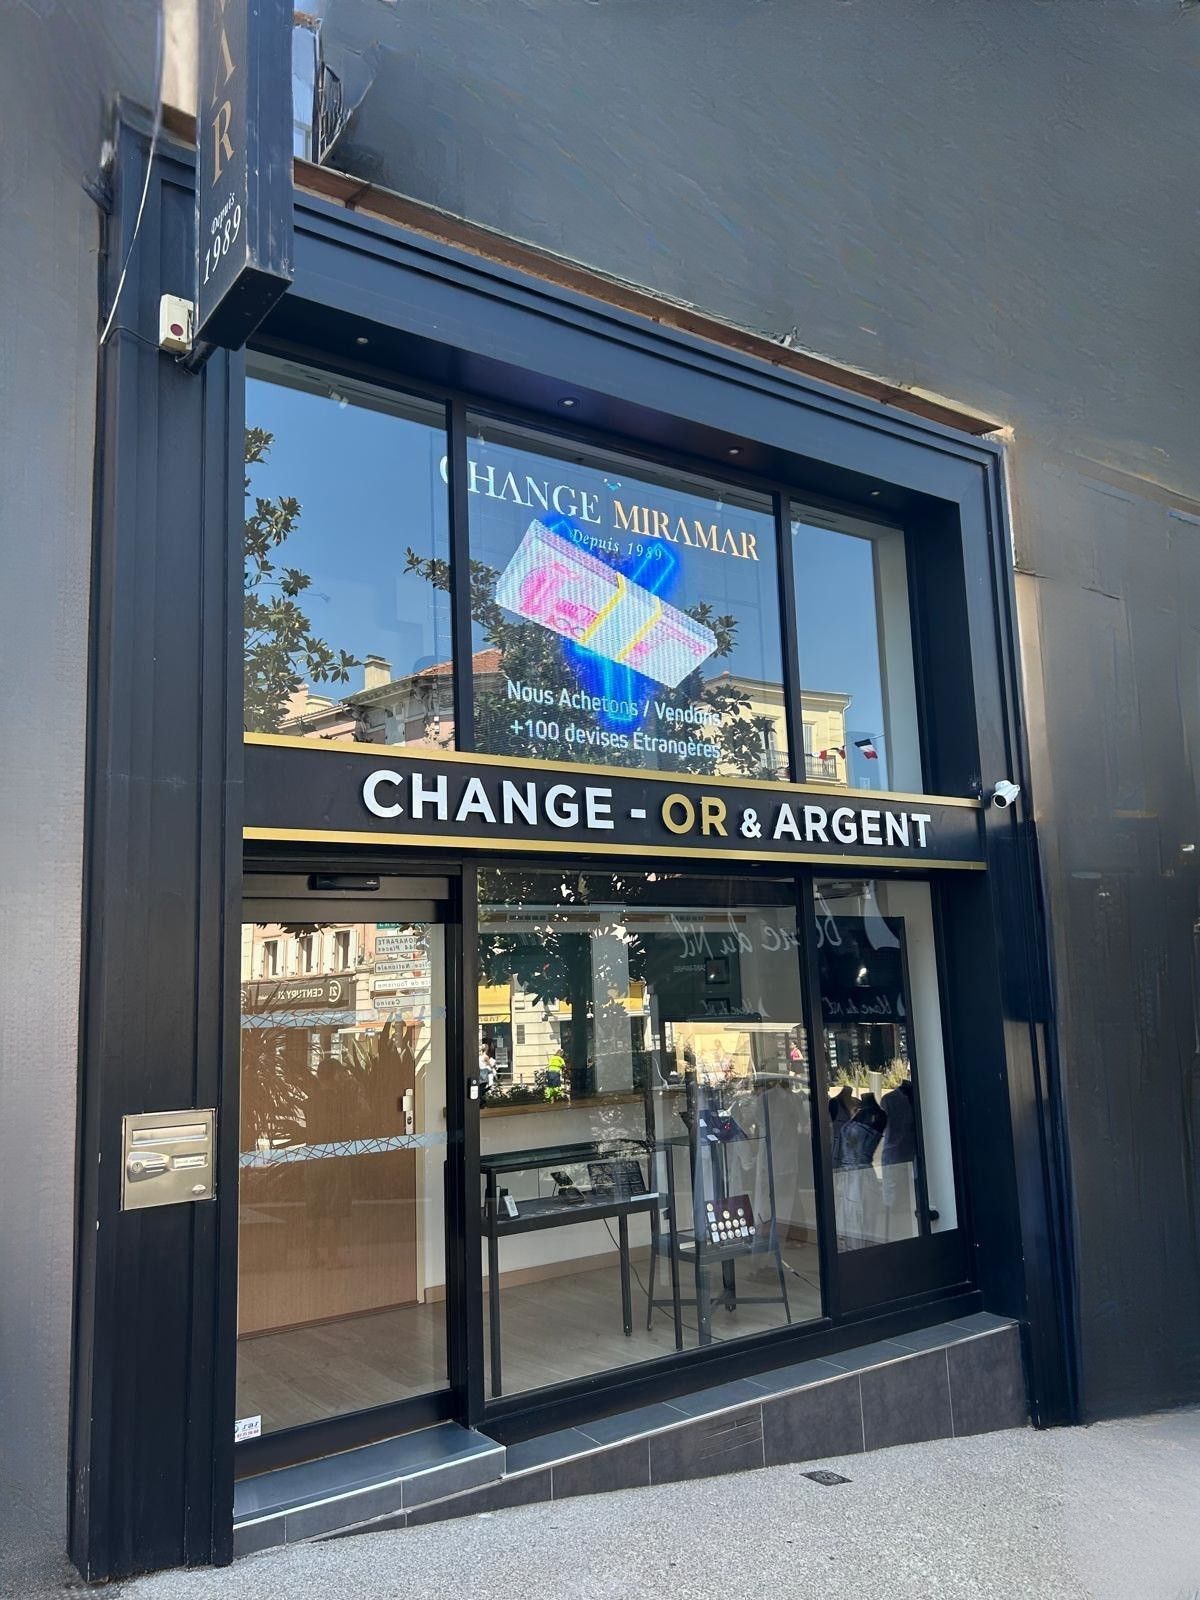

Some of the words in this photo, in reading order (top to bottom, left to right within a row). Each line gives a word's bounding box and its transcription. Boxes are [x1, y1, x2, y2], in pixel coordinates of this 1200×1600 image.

[203, 205, 241, 285] 1989
[571, 529, 619, 552] Depuis
[627, 542, 663, 561] 1989
[613, 500, 760, 561] MIRAMAR
[507, 680, 554, 705] Nous
[558, 688, 638, 717] Achetons
[643, 700, 650, 718] /
[654, 702, 721, 725] Vendons
[510, 719, 560, 741] +100
[565, 722, 629, 749] devises
[633, 727, 720, 759] Étrangères
[363, 769, 615, 831] CHANGE
[662, 792, 728, 837] OR
[741, 807, 763, 839] &
[772, 803, 932, 848] ARGENT
